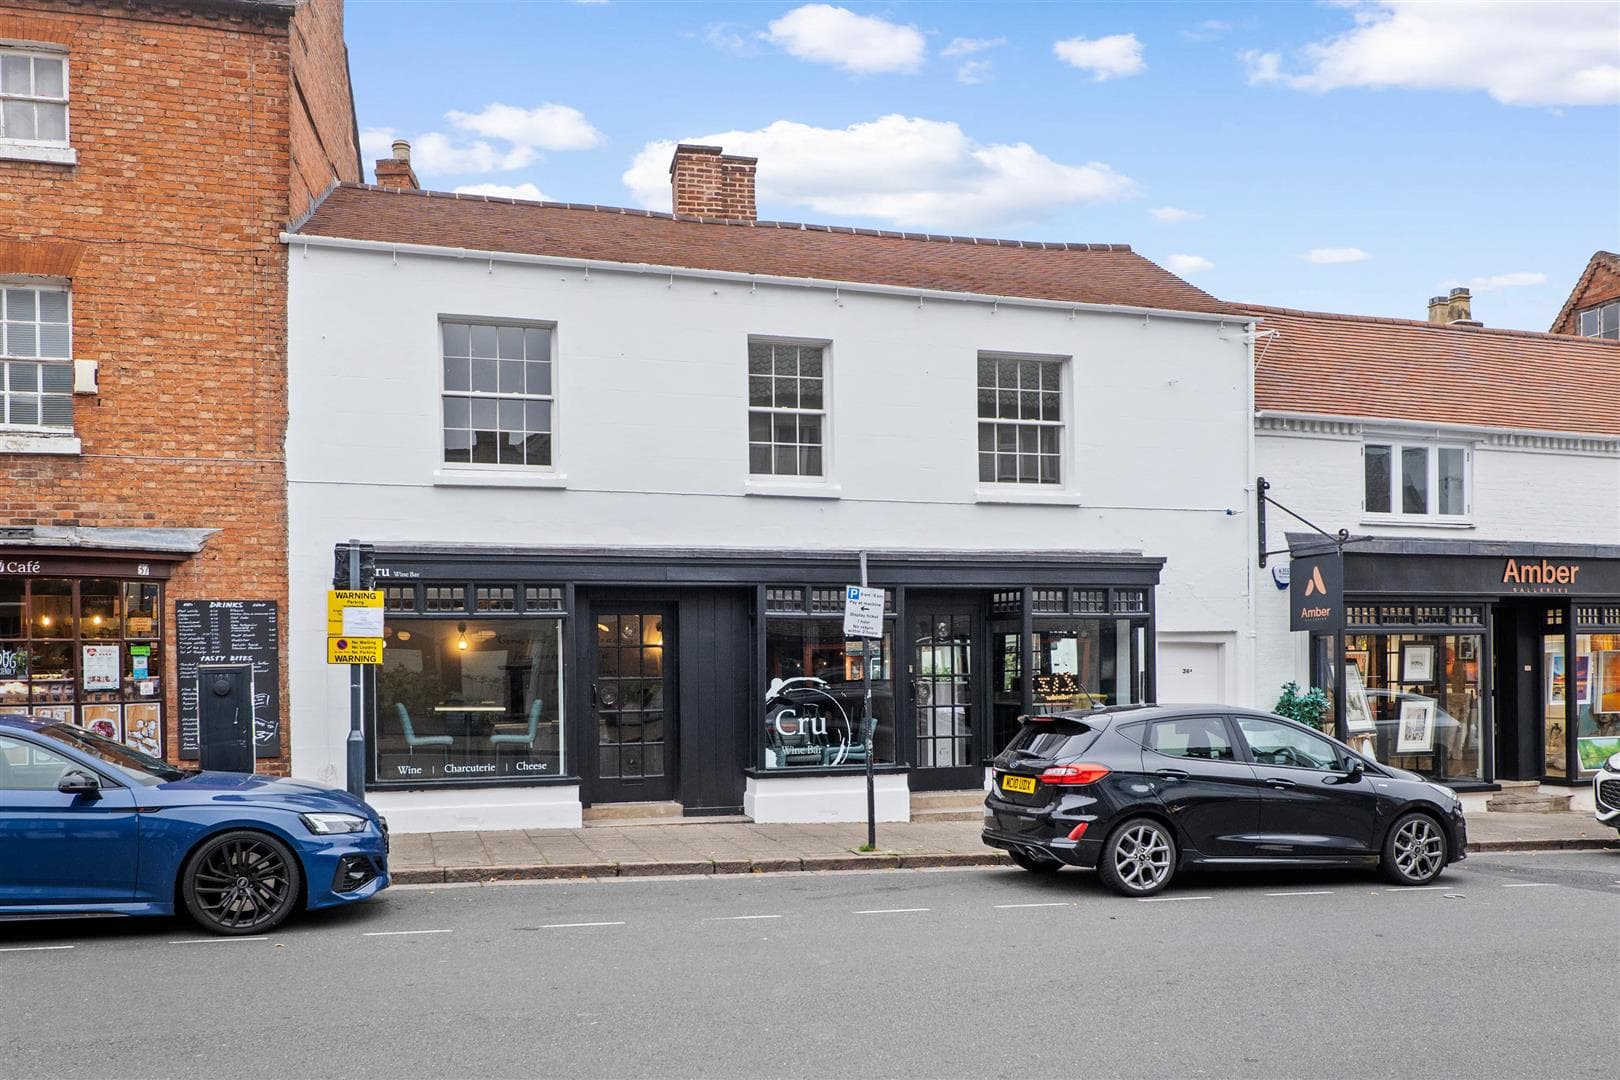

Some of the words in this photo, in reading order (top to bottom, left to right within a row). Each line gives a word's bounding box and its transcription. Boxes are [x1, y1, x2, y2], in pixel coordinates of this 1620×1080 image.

[7, 560, 41, 573] Café
[373, 568, 390, 577] ru
[1503, 559, 1579, 584] Amber
[851, 589, 859, 599] P
[1301, 606, 1331, 619] Amber
[334, 655, 377, 663] WARNING
[776, 709, 828, 735] Cru
[781, 745, 804, 754] Wine
[807, 745, 822, 754] Bar
[398, 765, 422, 774] Wine
[444, 763, 496, 773] Charcuterie
[516, 761, 547, 770] Cheese
